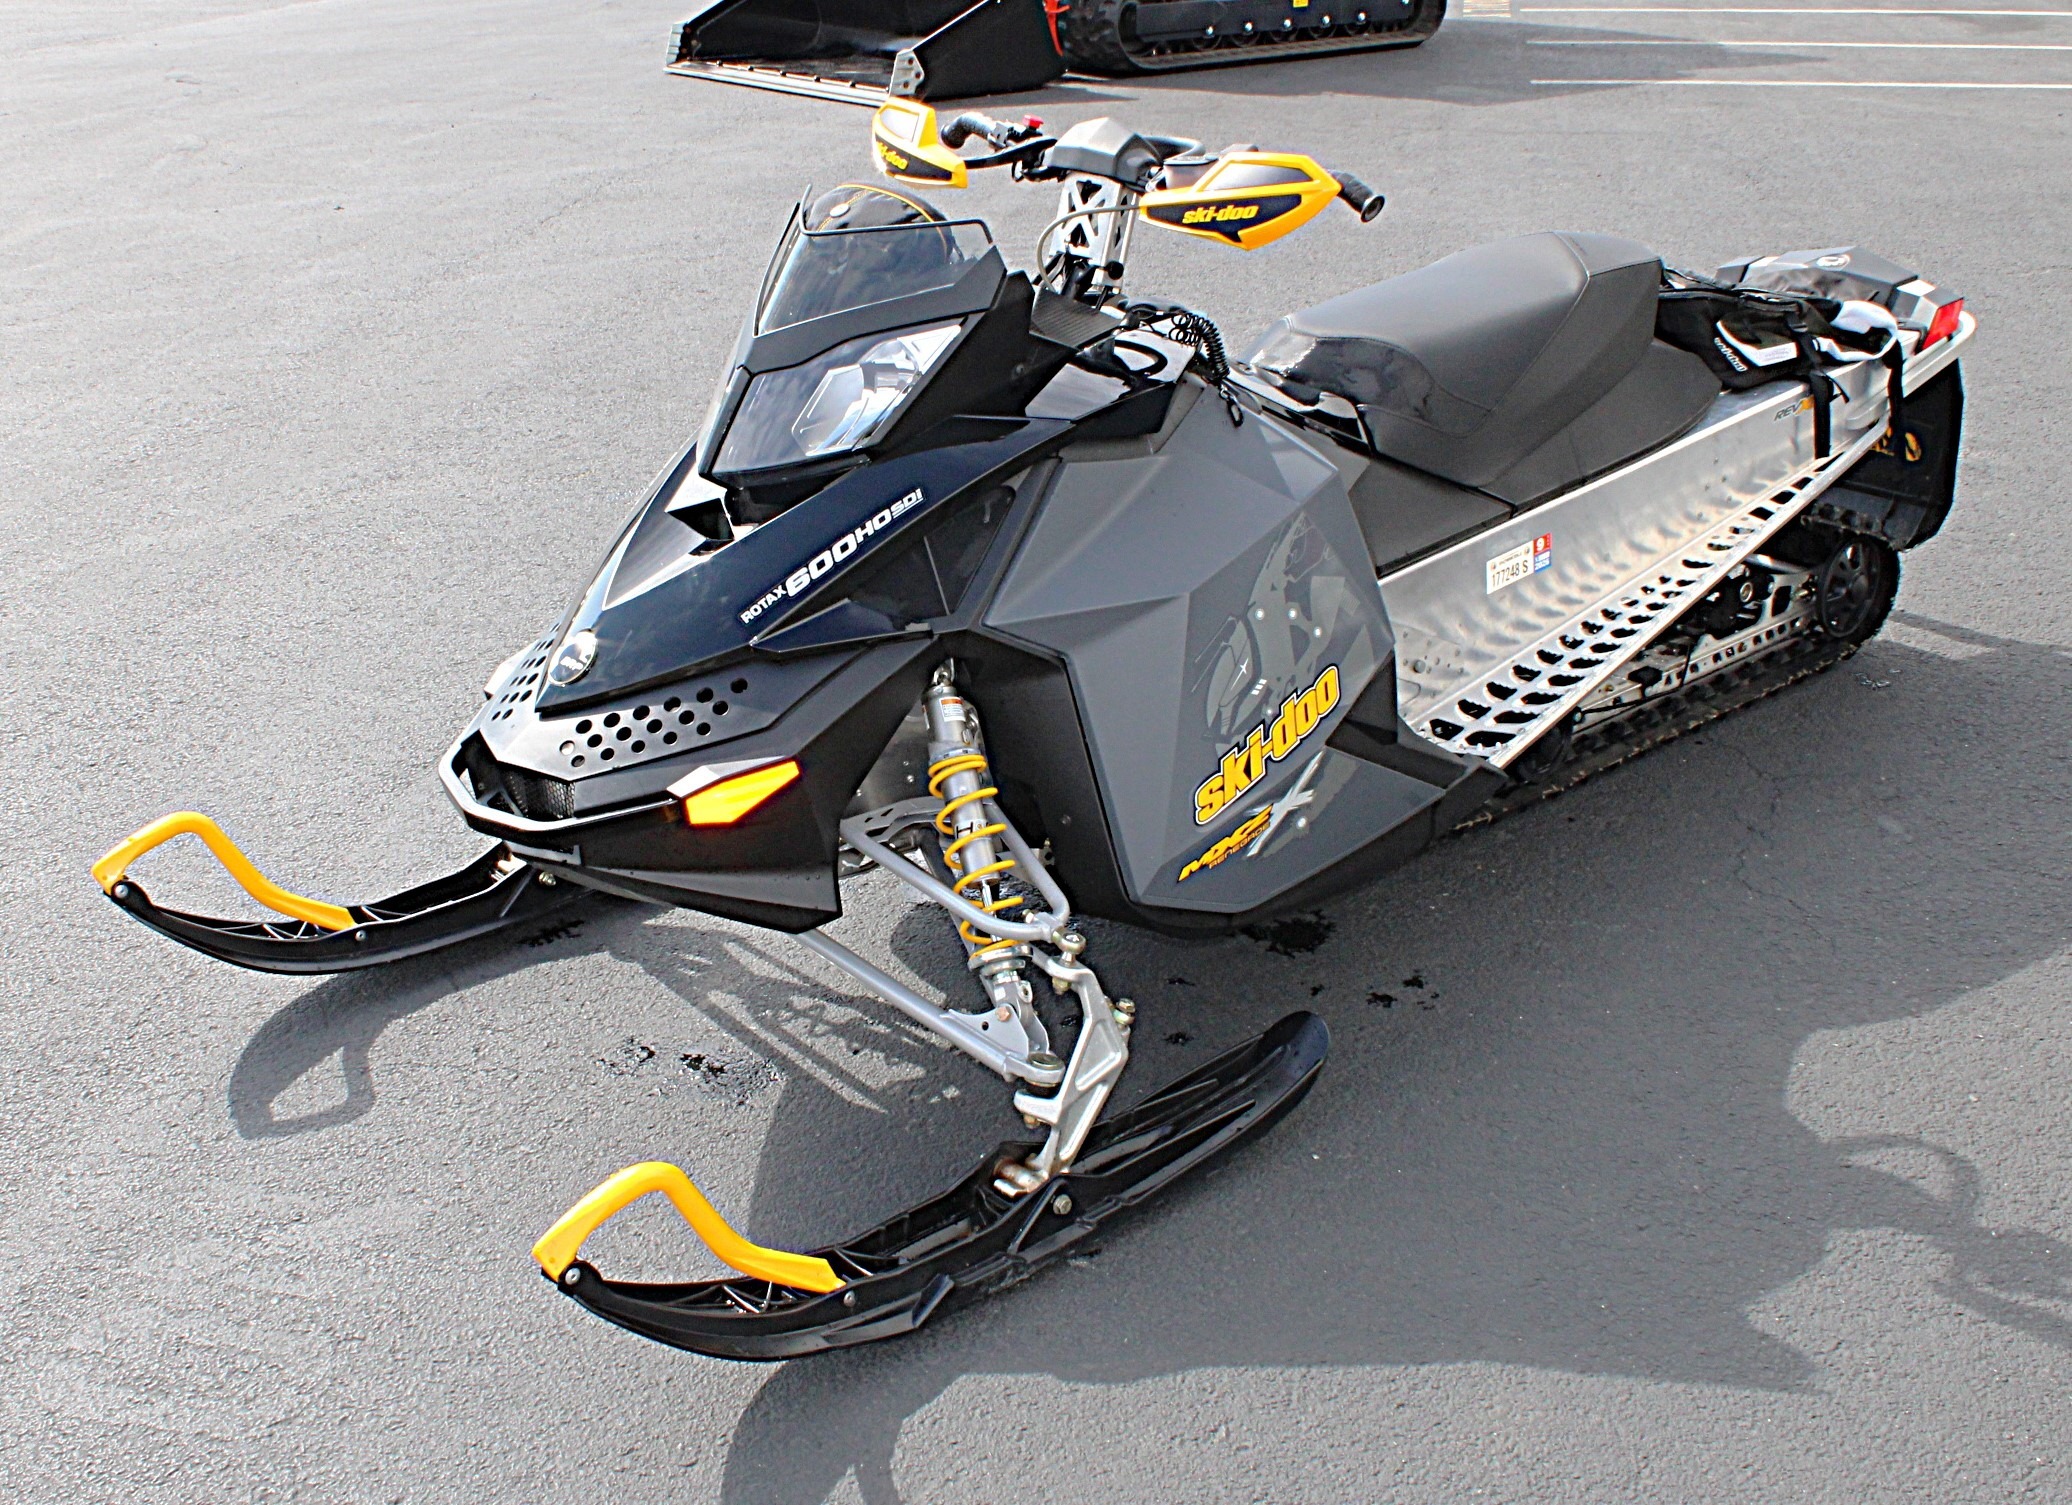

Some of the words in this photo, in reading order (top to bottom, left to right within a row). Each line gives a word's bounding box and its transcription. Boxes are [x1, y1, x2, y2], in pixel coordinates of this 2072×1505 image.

[1182, 204, 1259, 224] ski-doo
[1536, 537, 1545, 552] 9
[1522, 559, 1529, 574] S
[740, 584, 787, 624] ROTAX
[1195, 665, 1339, 825] ski-doo
[1208, 821, 1272, 870] RENEGADE
